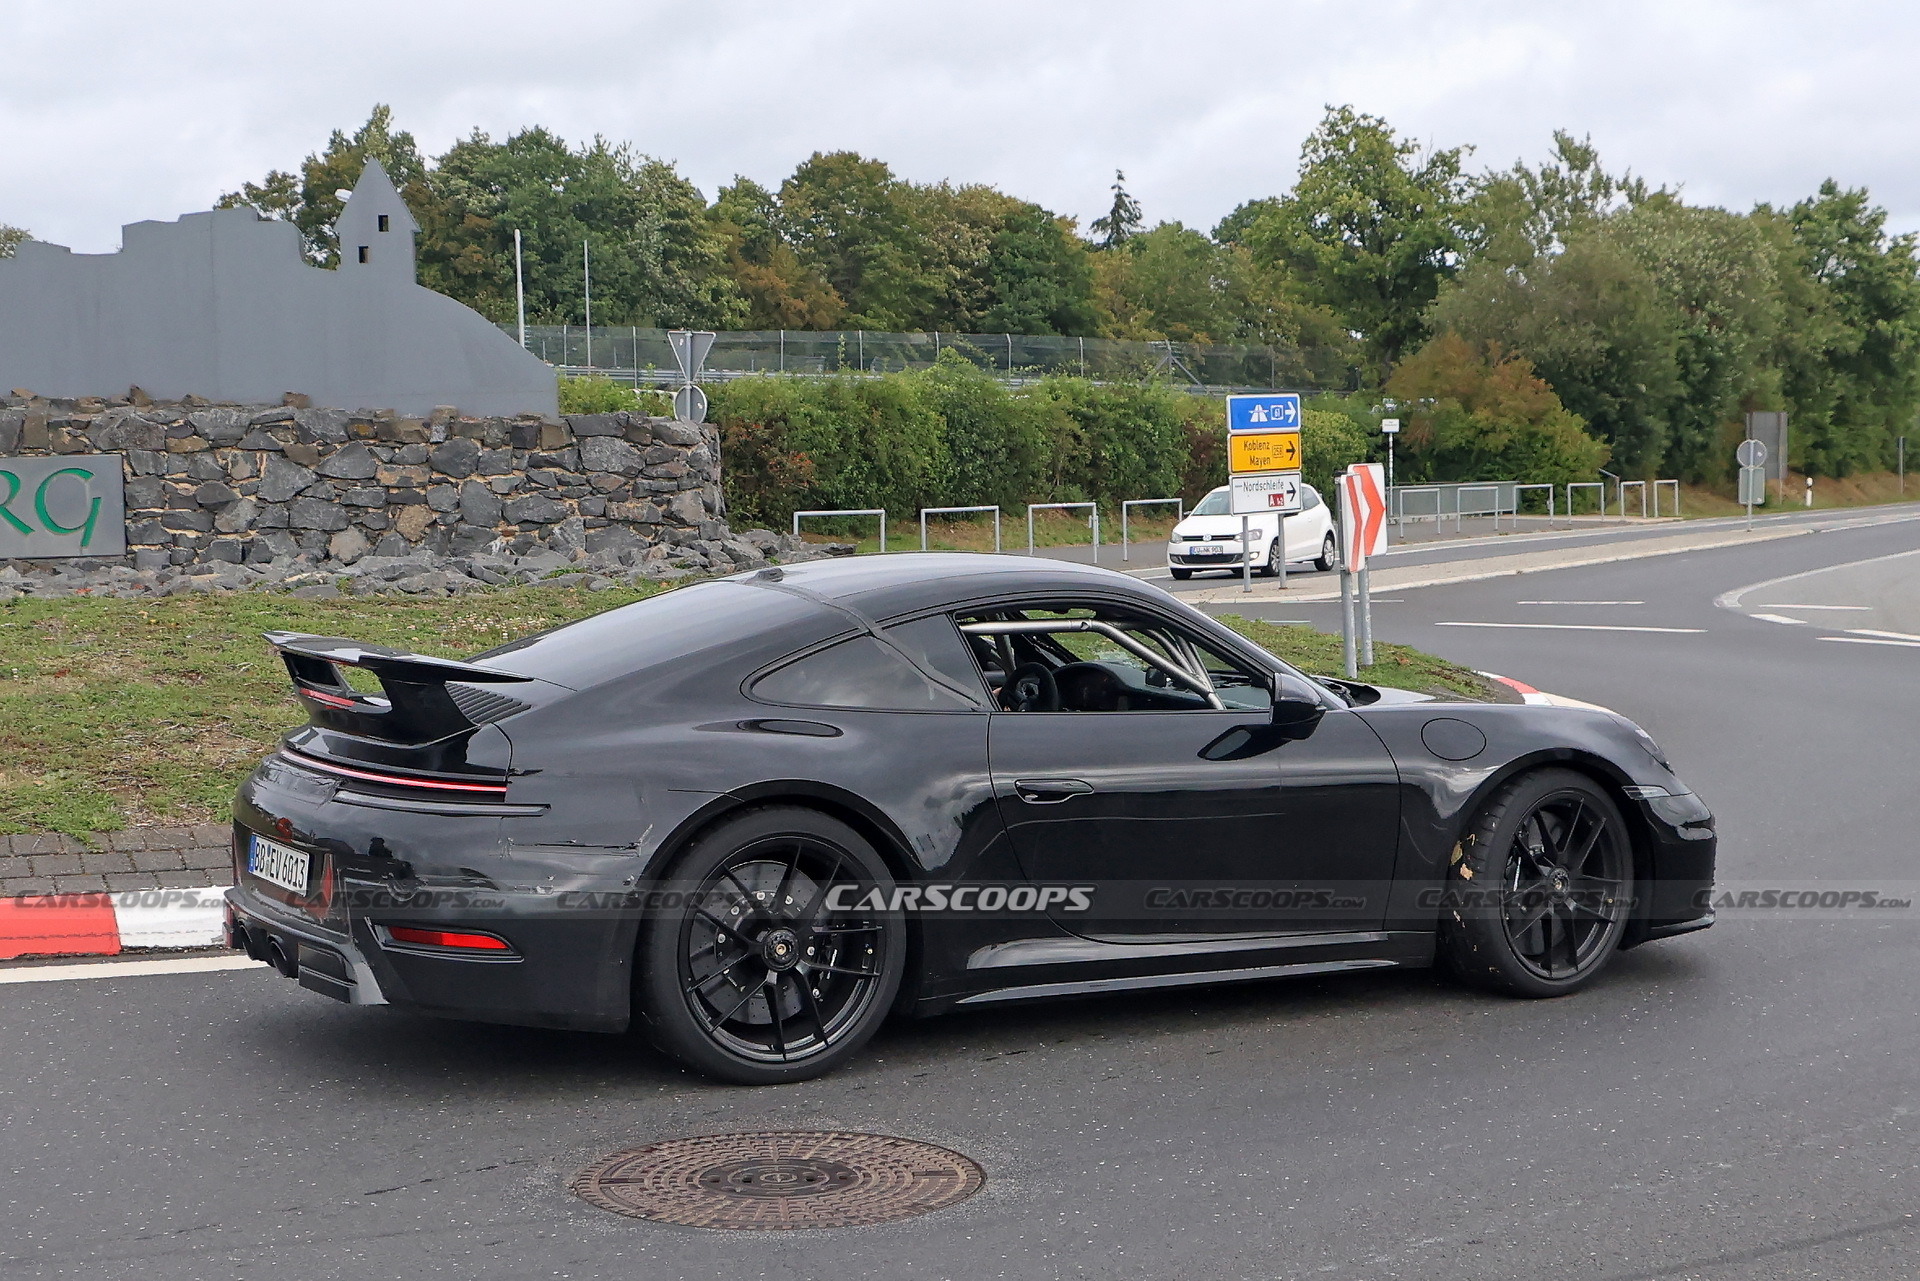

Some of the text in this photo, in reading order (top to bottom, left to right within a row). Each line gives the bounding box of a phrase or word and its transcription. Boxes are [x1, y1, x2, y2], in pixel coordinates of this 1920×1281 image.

[1243, 440, 1270, 451] Koblenz
[1250, 455, 1271, 468] Mayen
[1243, 479, 1284, 492] Nordschleife
[254, 842, 306, 889] BB EV 6013
